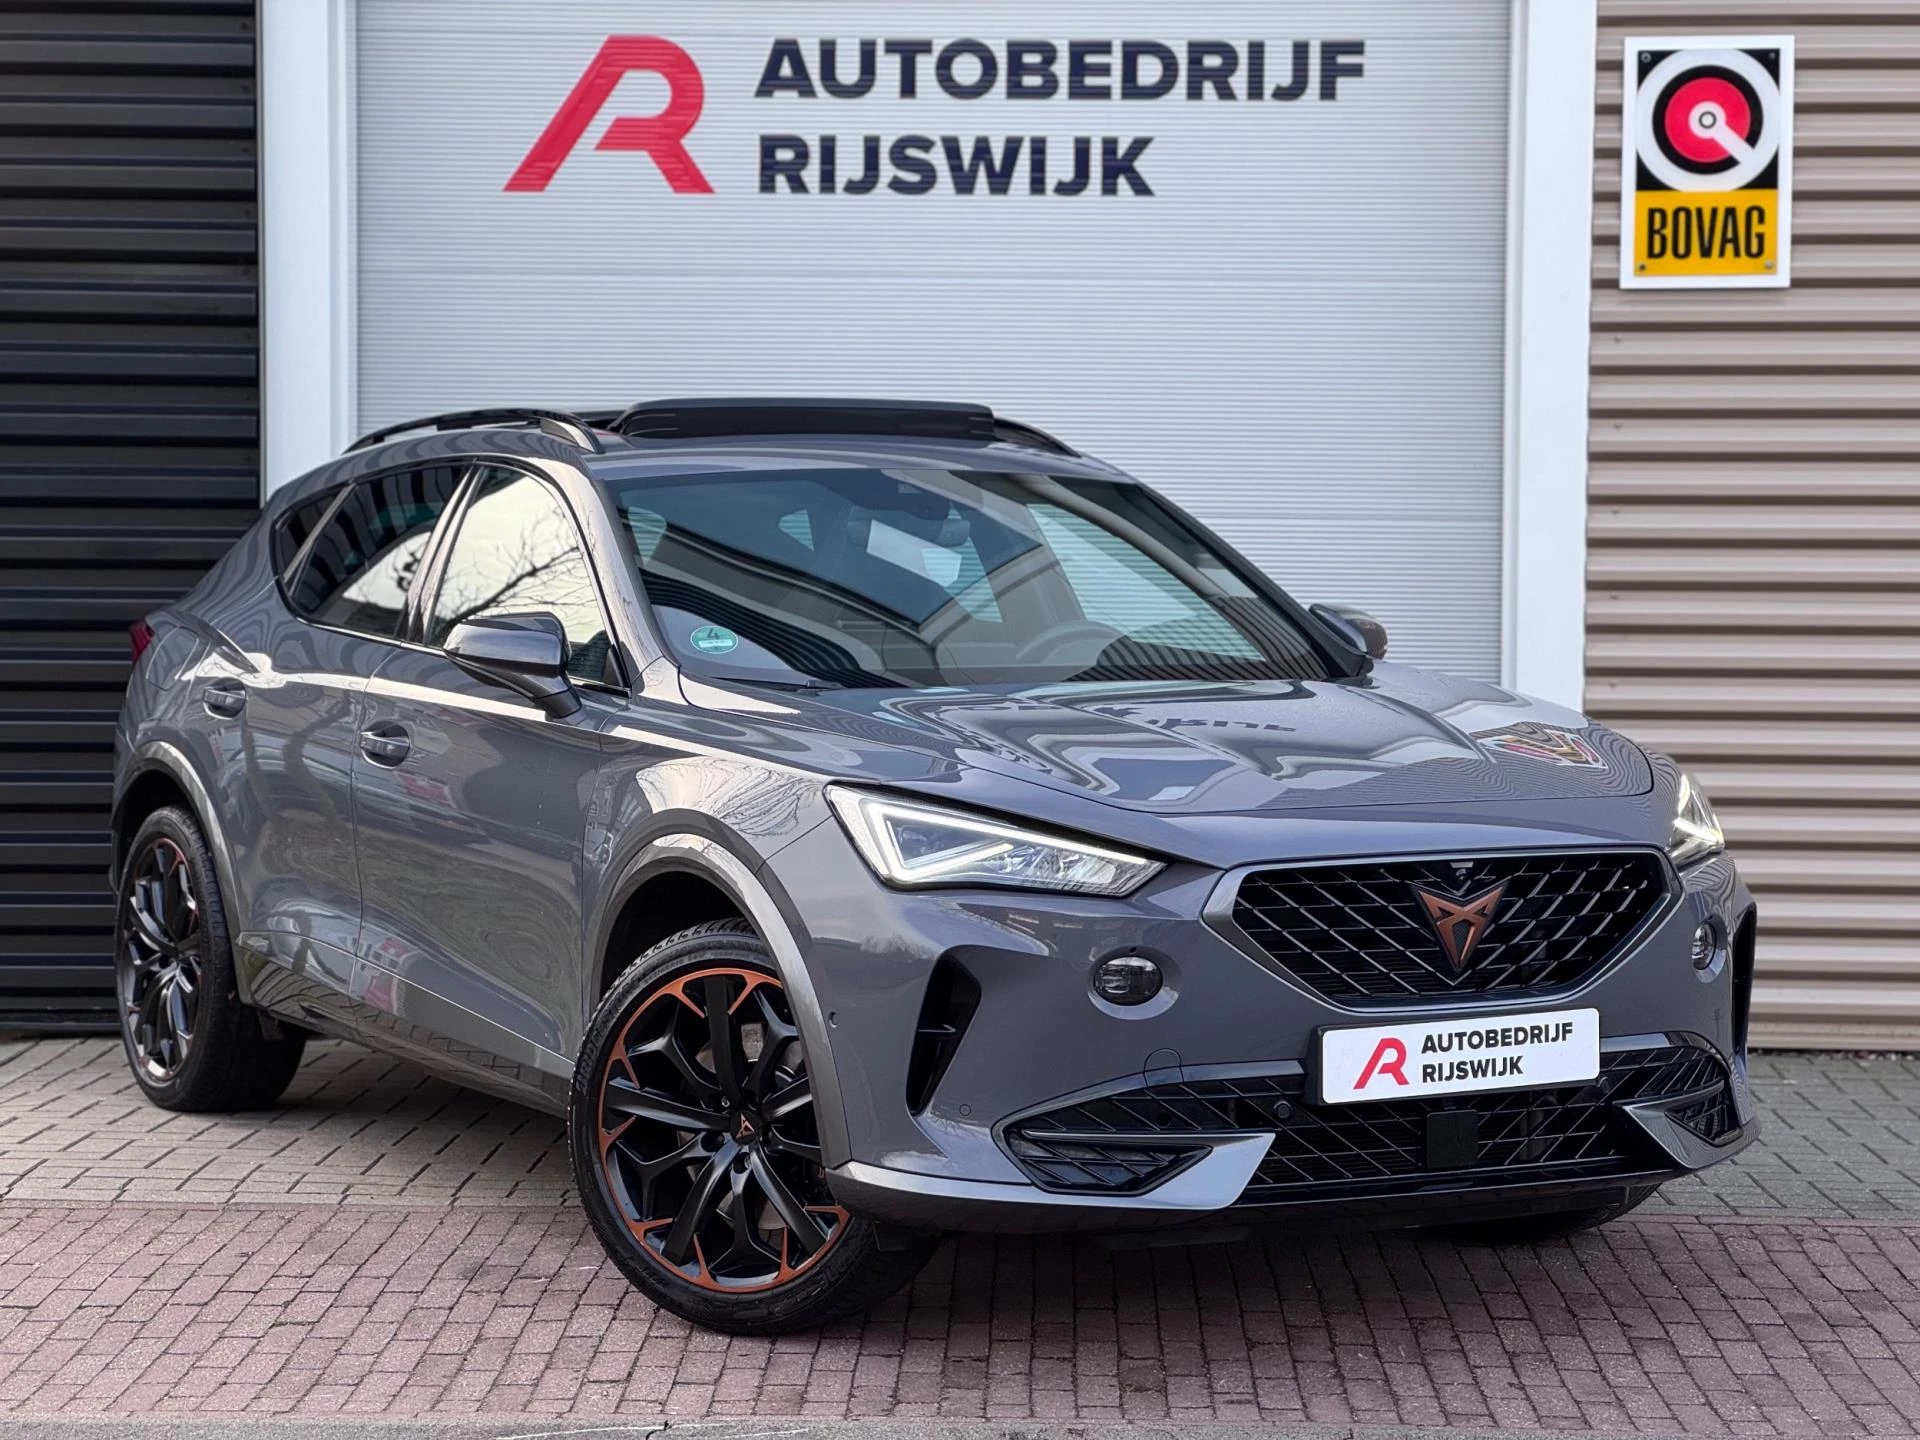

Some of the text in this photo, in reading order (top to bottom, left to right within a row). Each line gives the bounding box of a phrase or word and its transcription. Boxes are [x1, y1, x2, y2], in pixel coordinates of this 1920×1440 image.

[755, 38, 1364, 101] AUTOBEDRIJF
[759, 135, 1155, 196] RIJSWIJK
[1647, 205, 1765, 259] BOVAG
[1421, 1022, 1573, 1054] AUTOBEDRIJF
[1422, 1056, 1523, 1083] RIJSWIJK
